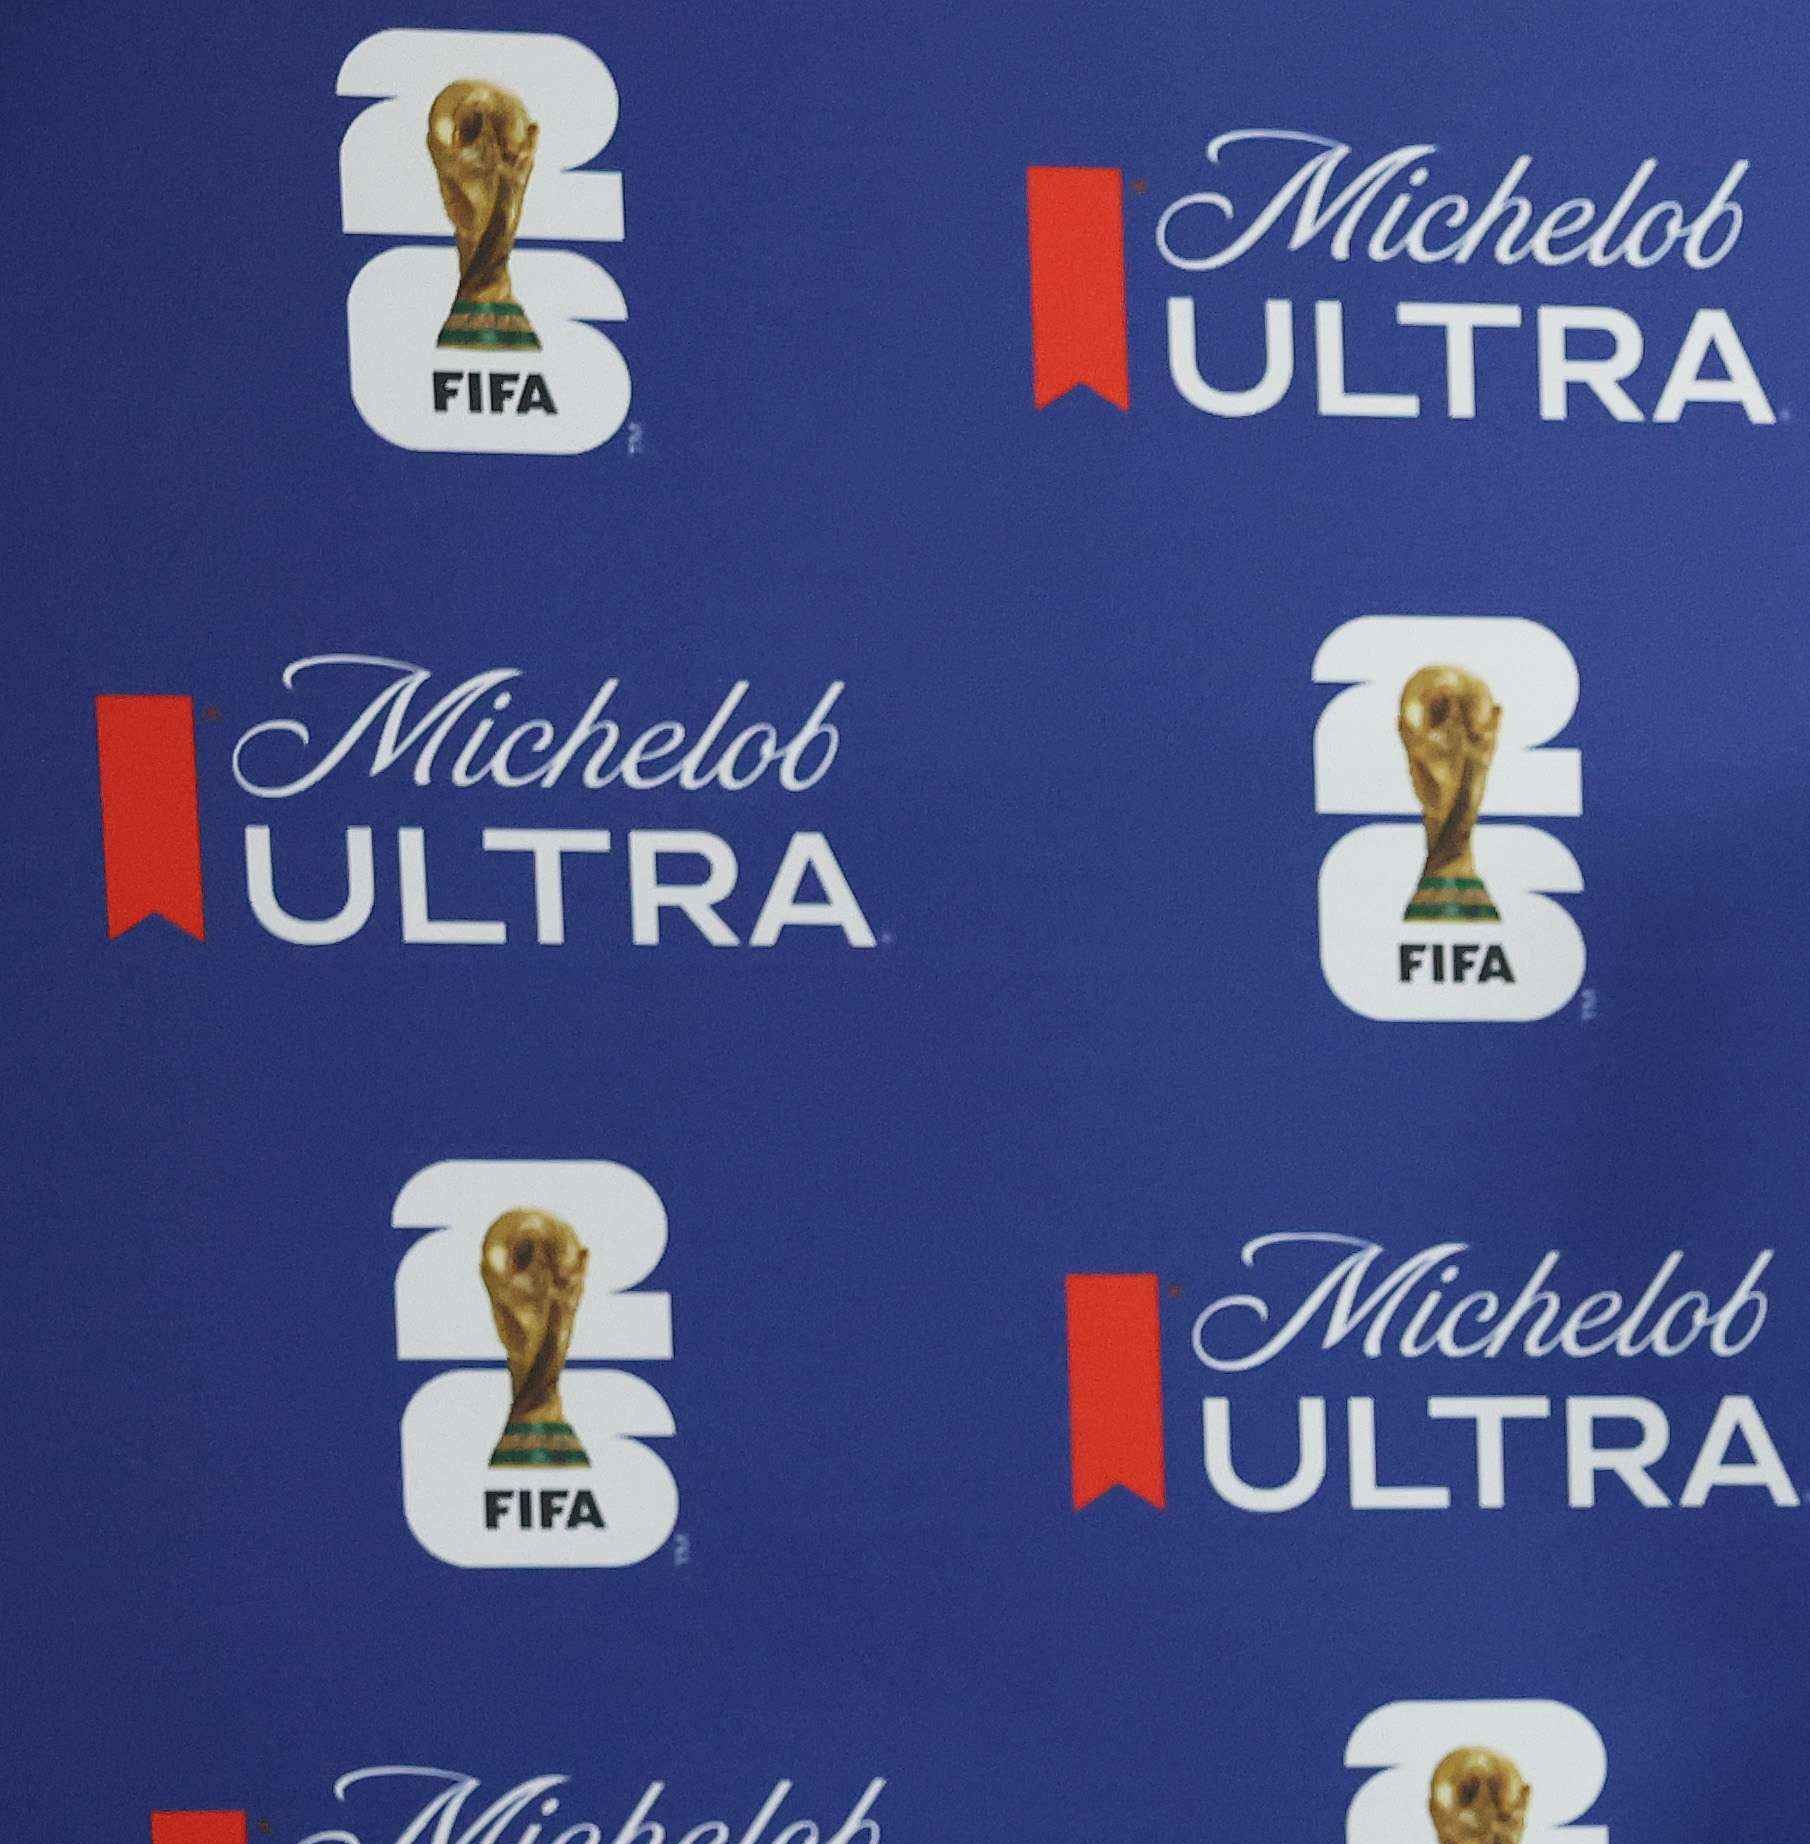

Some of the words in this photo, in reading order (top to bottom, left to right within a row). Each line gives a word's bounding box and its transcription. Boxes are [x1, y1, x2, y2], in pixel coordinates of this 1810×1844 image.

[1156, 129, 1749, 270] Michelob
[431, 369, 559, 416] FIFA
[1167, 297, 1776, 425] ULTRA
[232, 654, 845, 797] Michelob
[245, 825, 877, 947] ULTRA
[1397, 942, 1517, 985] FIFA
[1192, 1233, 1773, 1371] Michelob
[482, 1488, 607, 1531] FIFA
[1203, 1395, 1800, 1512] ULTRA
